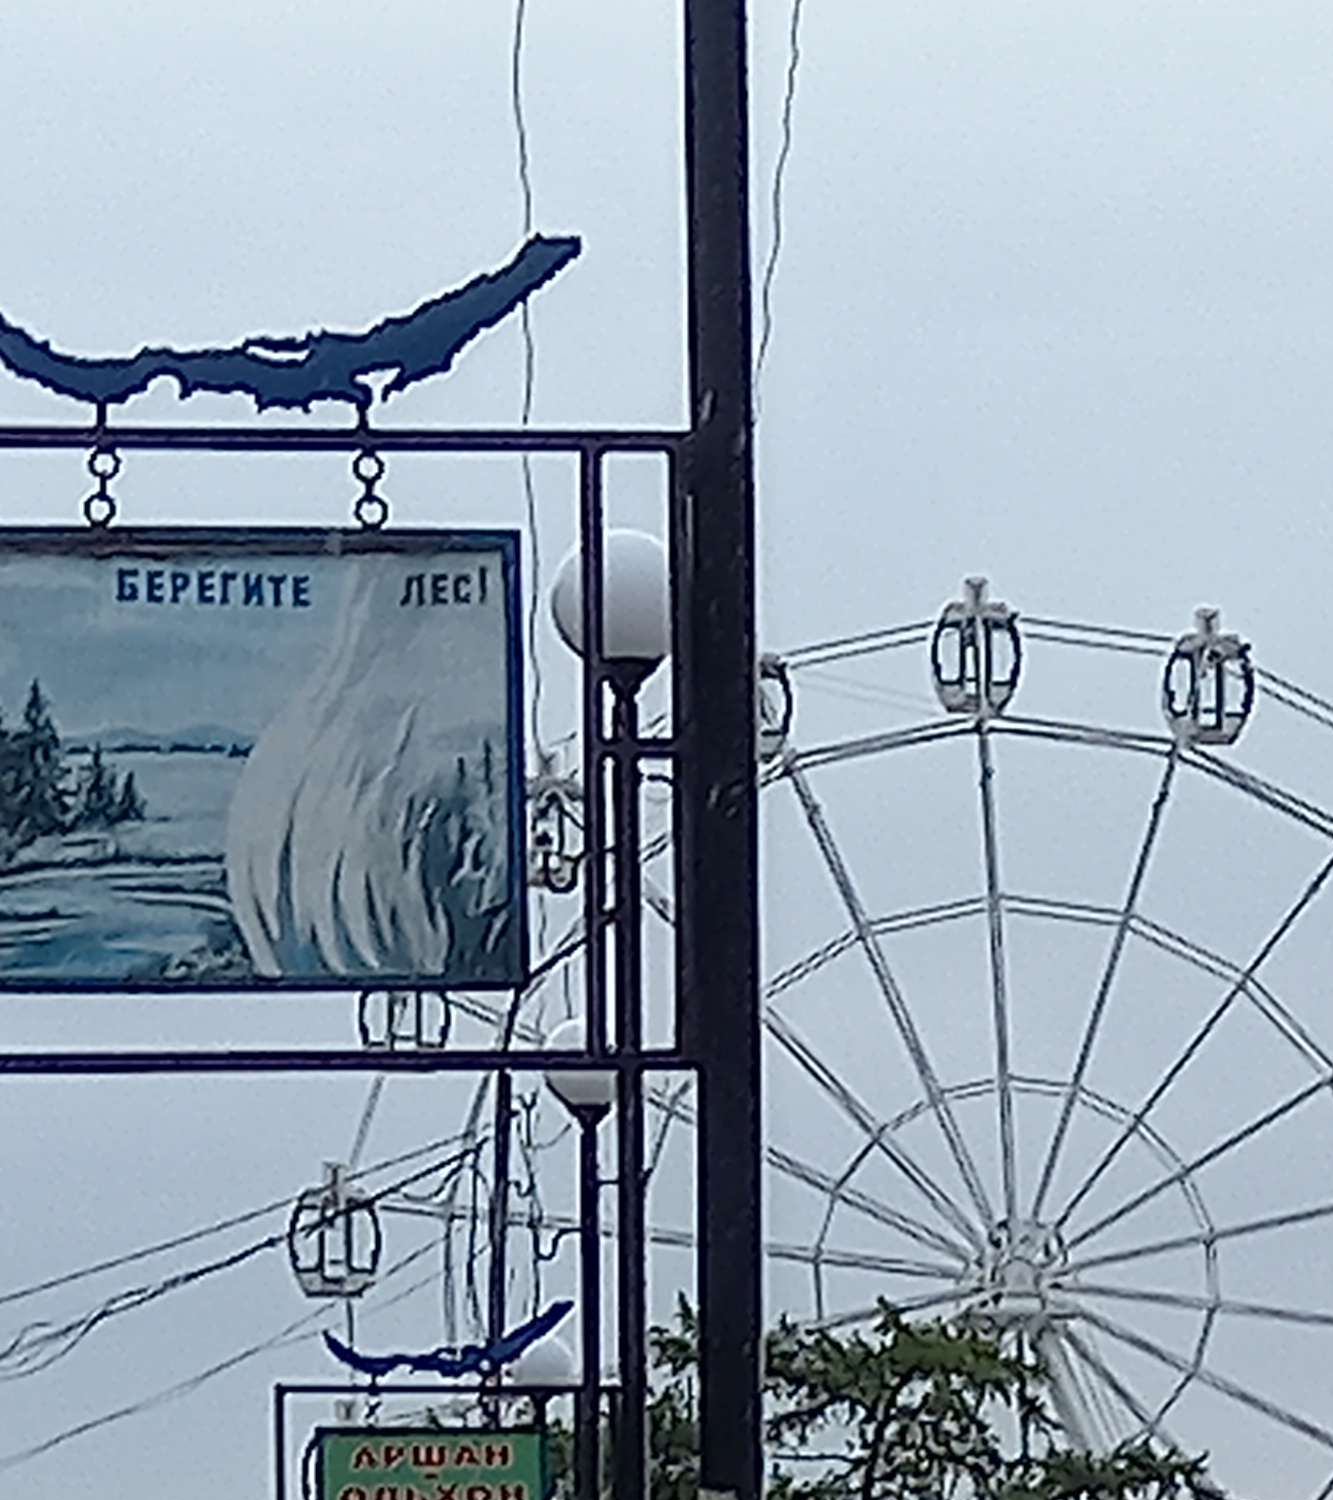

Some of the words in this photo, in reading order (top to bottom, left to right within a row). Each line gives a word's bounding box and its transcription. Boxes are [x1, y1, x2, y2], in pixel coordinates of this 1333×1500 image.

[115, 568, 312, 607] БЕРЕГИТЕ
[400, 566, 488, 606] ЛЕС!
[352, 1444, 511, 1469] АРШАН
